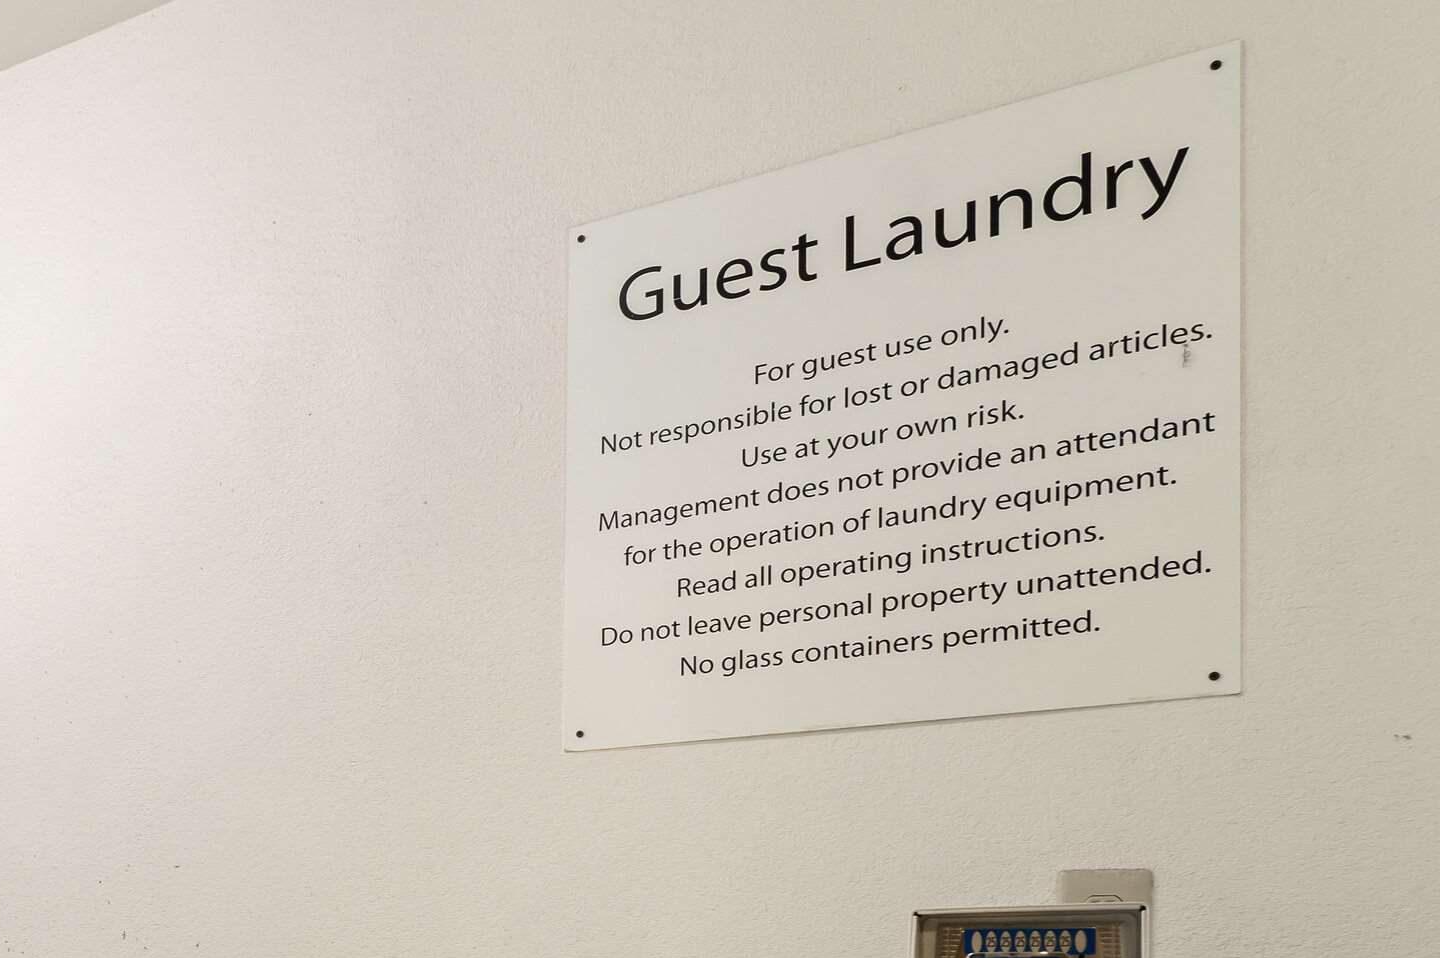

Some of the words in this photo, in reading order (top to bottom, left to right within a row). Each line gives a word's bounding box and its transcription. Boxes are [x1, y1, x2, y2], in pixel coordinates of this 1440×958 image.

[618, 233, 819, 321] Guest
[845, 146, 1190, 272] Laundry
[601, 431, 643, 455] Not
[650, 401, 792, 446] responsible
[799, 394, 836, 417] for
[844, 382, 893, 409] lost
[900, 377, 930, 397] or
[937, 341, 1079, 390] damaged
[1089, 323, 1213, 361] articles.
[755, 362, 795, 385] For
[802, 343, 877, 381] guest
[885, 334, 932, 358] use
[940, 316, 1009, 346] only.
[599, 489, 760, 532] Management
[767, 480, 829, 504] does
[838, 468, 884, 493] not
[892, 447, 1002, 490] provide
[1010, 444, 1046, 465] an
[1056, 412, 1216, 457] attendant
[742, 446, 787, 468] Use
[794, 438, 820, 459] at
[827, 427, 889, 459] your
[896, 416, 957, 440] own
[967, 399, 1024, 428] risk.
[623, 545, 657, 566] for
[662, 539, 703, 560] the
[709, 521, 834, 556] operation
[842, 508, 872, 533] of
[878, 495, 987, 529] laundry
[995, 466, 1177, 512] equipment.
[677, 569, 737, 598] Read
[744, 564, 772, 589] all
[780, 551, 912, 587] operating
[921, 525, 1105, 565] instructions.
[601, 627, 633, 647] Do
[641, 621, 681, 642] not
[688, 614, 752, 636] leave
[759, 592, 872, 633] personal
[882, 581, 1008, 618] property
[1017, 550, 1211, 596] unattended.
[680, 655, 714, 676] No
[721, 649, 783, 677] glass
[791, 634, 933, 664] containers
[943, 609, 1100, 654] permitted.
